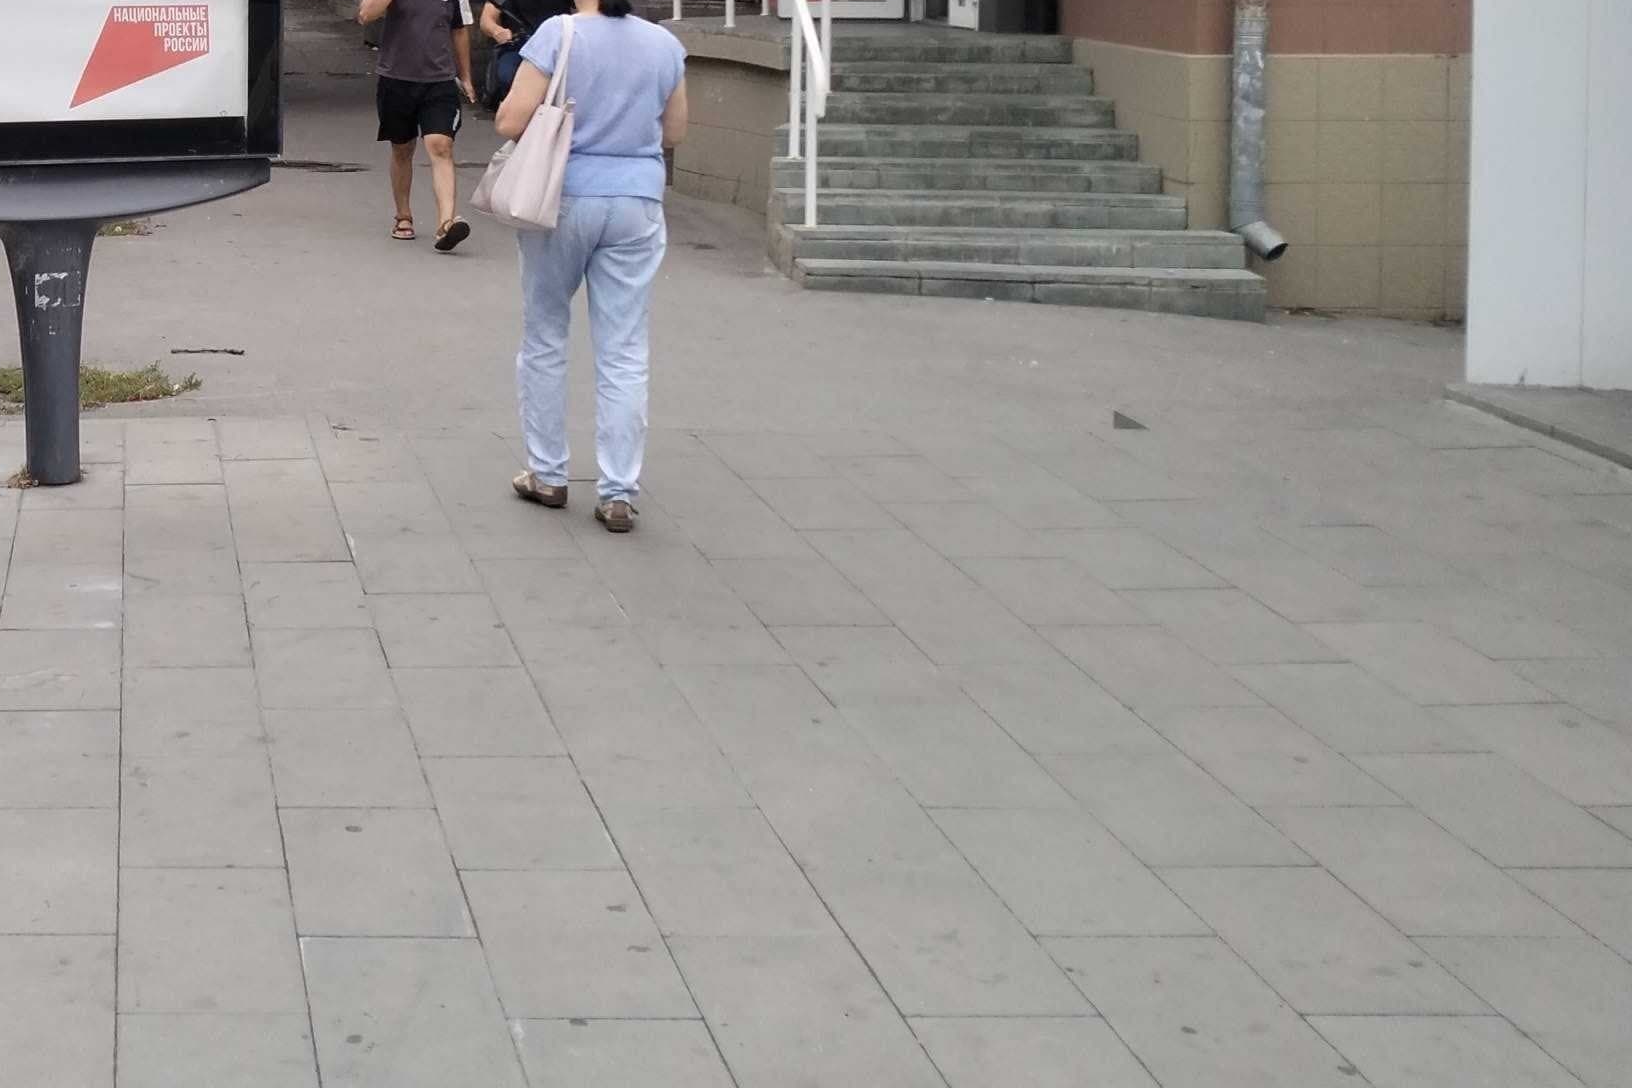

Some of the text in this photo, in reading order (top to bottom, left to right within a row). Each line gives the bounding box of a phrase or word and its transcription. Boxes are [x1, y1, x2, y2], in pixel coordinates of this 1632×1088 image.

[113, 7, 208, 23] НАЦИОНАЛЬНЫЕ
[154, 22, 208, 38] ПРОЕКТЫ
[164, 37, 208, 52] РОССИИ
